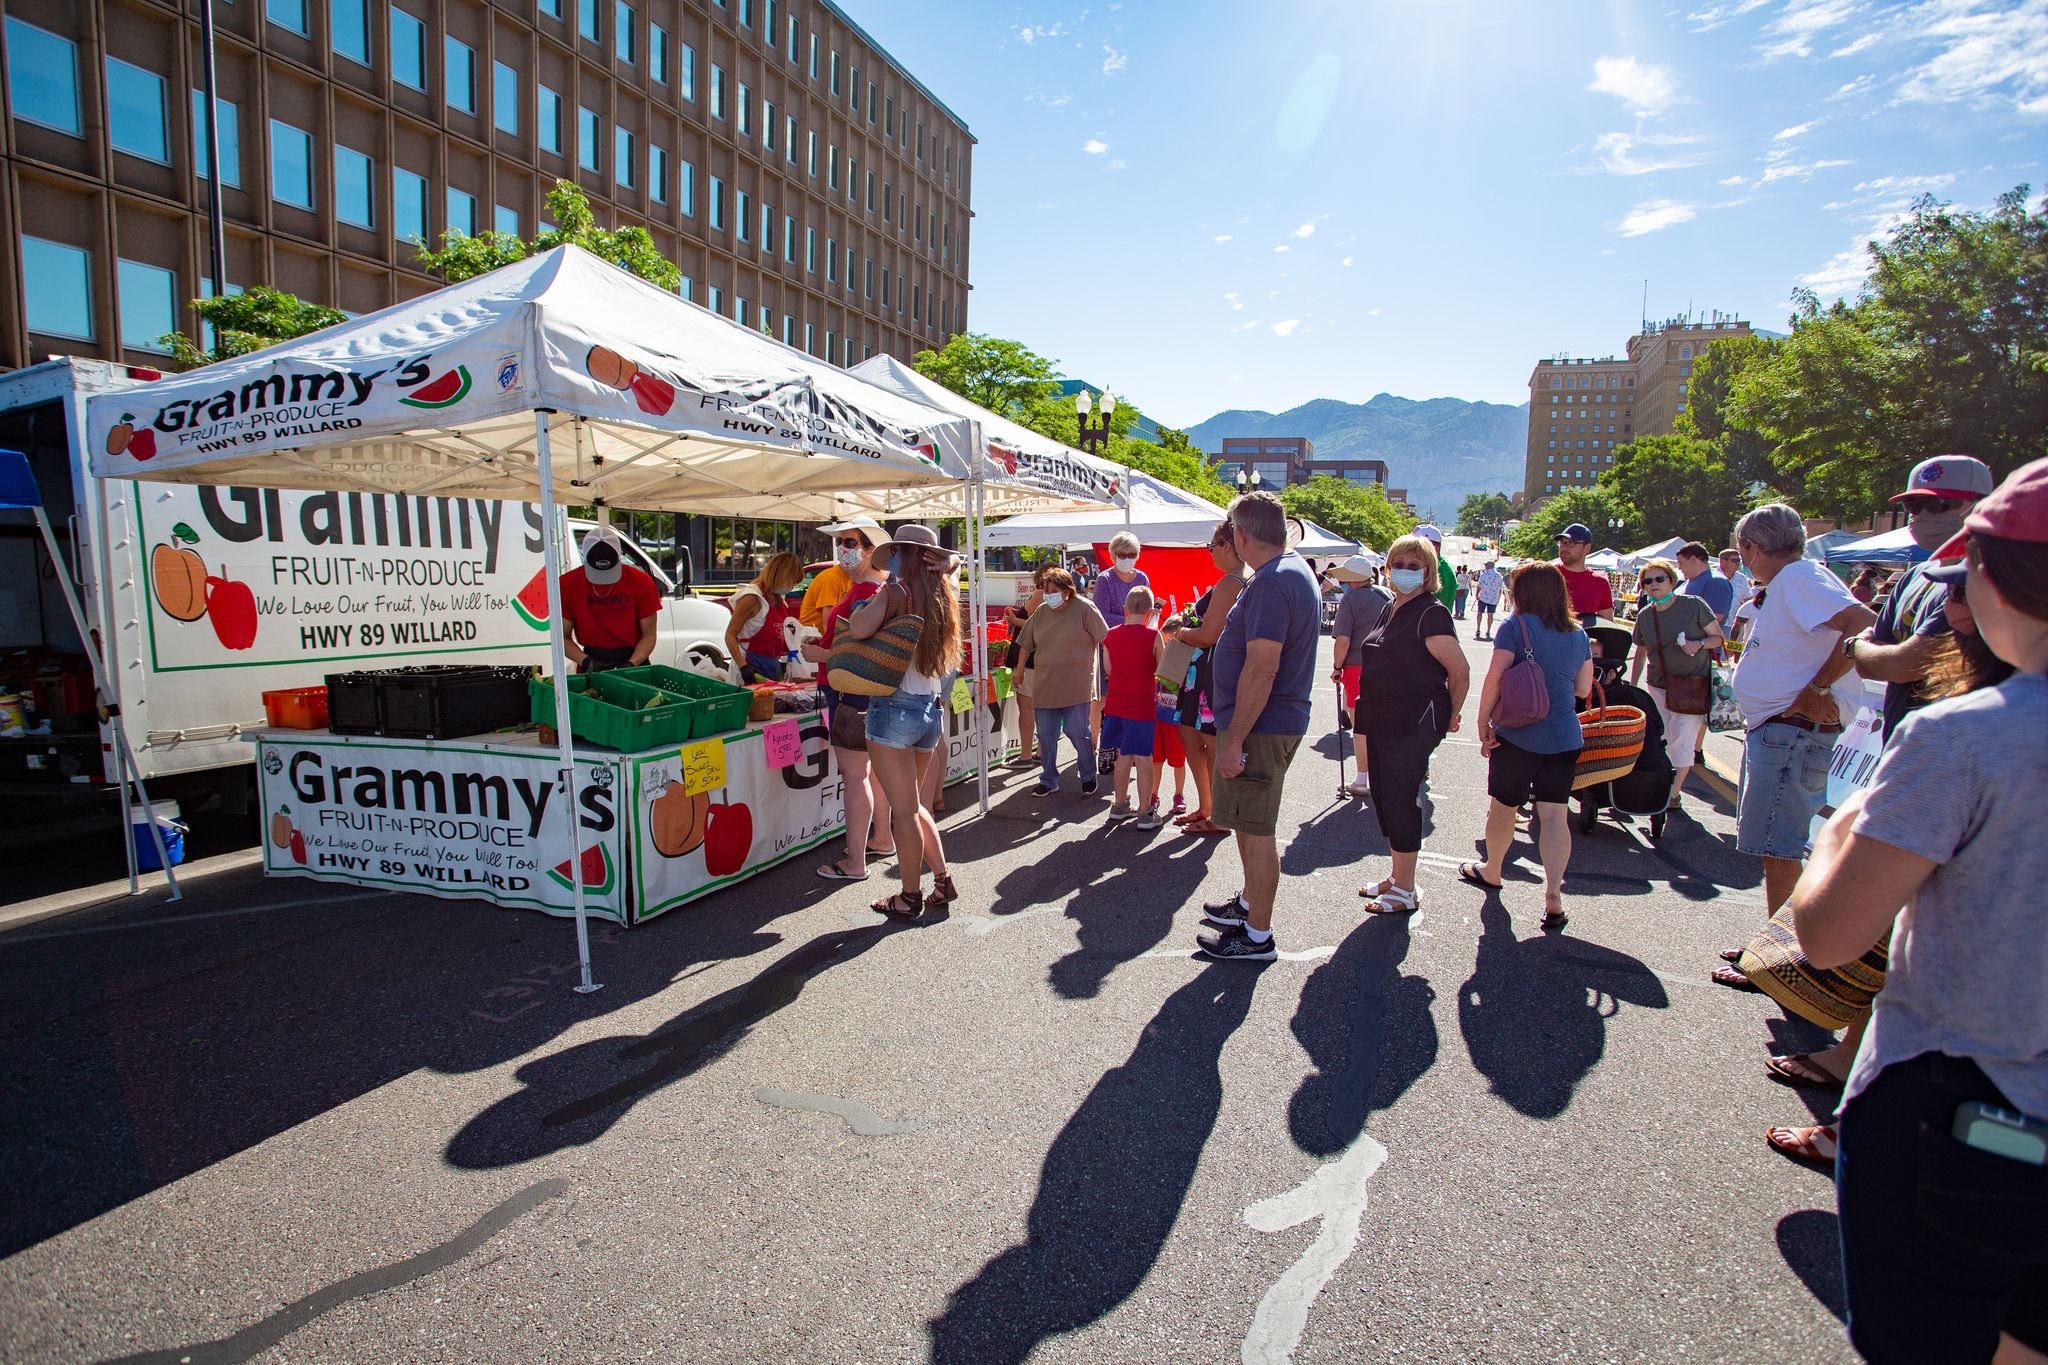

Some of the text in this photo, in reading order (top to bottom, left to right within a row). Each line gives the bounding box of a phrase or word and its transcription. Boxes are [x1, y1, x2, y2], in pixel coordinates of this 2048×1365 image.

[153, 354, 433, 433] Grammy's
[177, 402, 346, 446] FRUIT-N-PRODUCE
[197, 417, 363, 454] HWY 89 WILLARD
[723, 419, 882, 460] HWY 89 WILLARD
[272, 556, 484, 587] FRUIT-N-PRODUCE
[256, 591, 510, 617] We Love Our Fruit, You Will Too!
[299, 620, 477, 650] HWY 89 WILLARD
[289, 750, 615, 839] Grammy's
[319, 810, 525, 847] FRUIT-N-PRODUCE
[774, 818, 834, 852] We Love
[303, 833, 540, 873] We Love Our Fruit, You Will Too!
[319, 853, 530, 891] HWY 89 WILLARD
